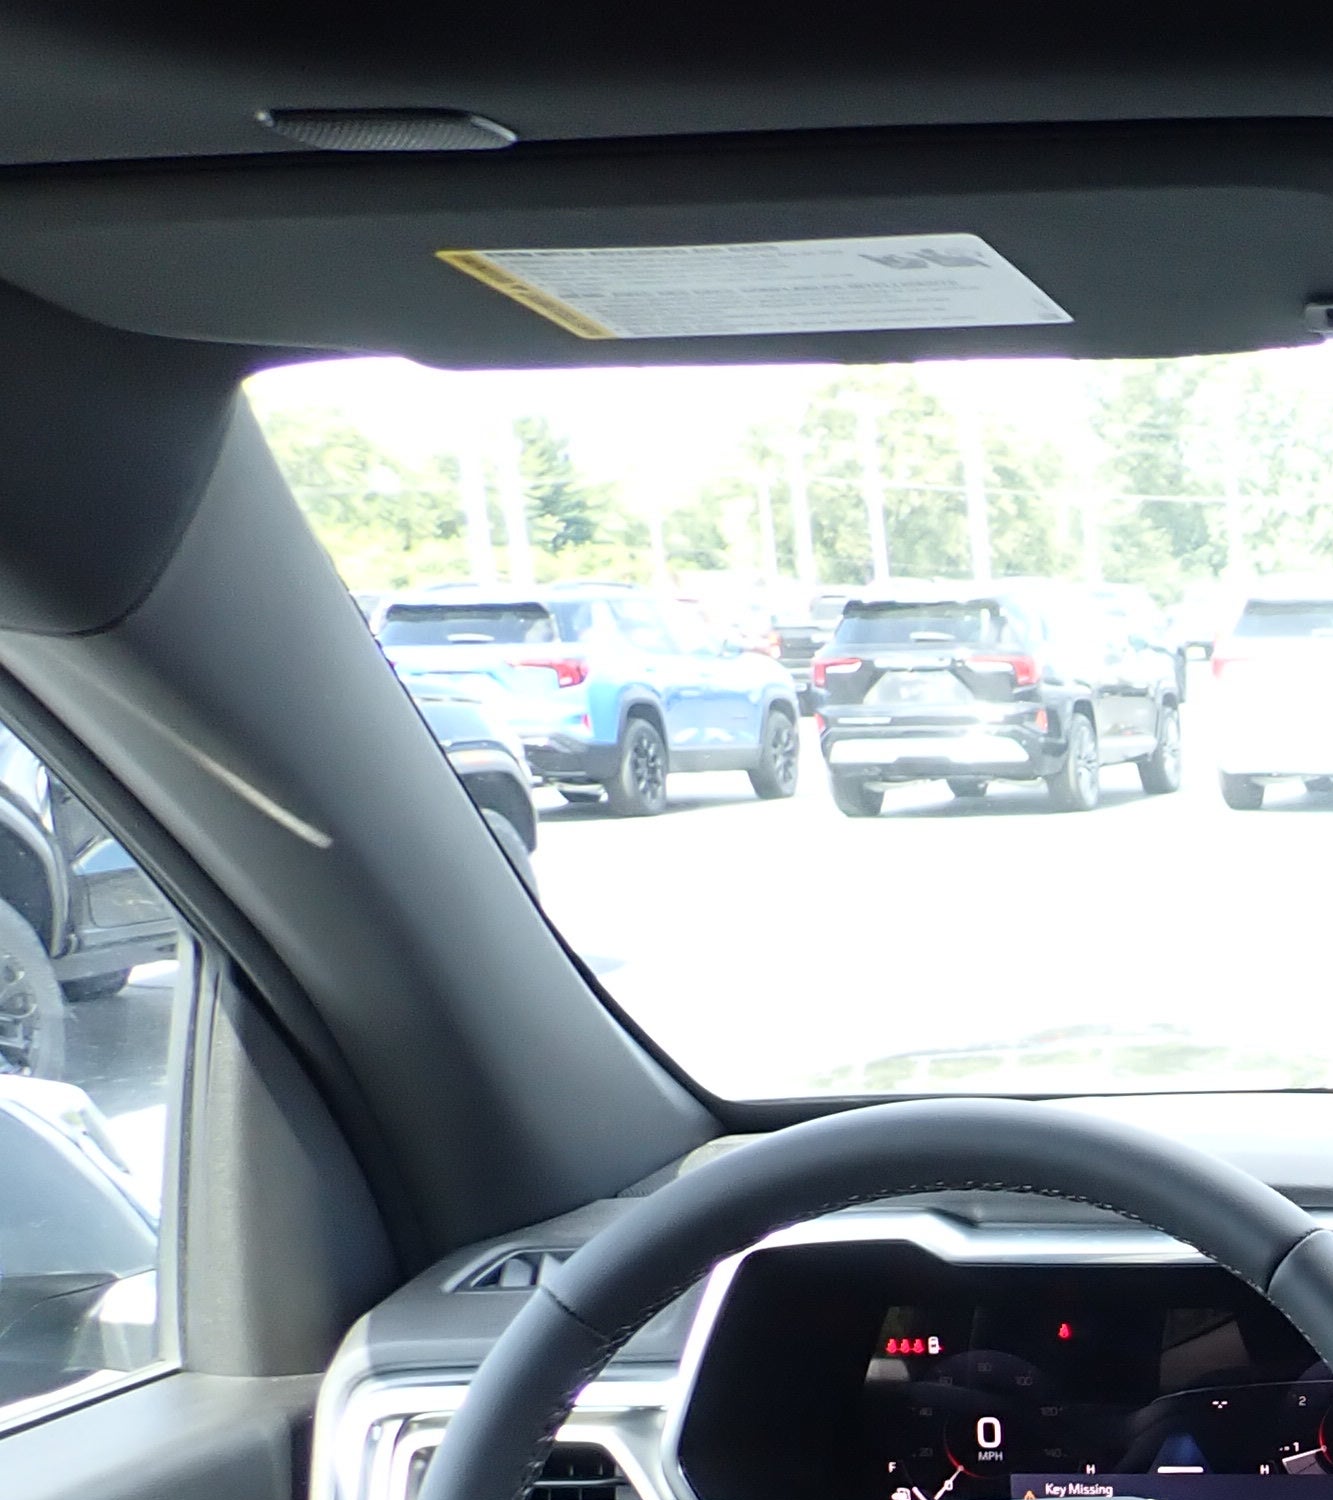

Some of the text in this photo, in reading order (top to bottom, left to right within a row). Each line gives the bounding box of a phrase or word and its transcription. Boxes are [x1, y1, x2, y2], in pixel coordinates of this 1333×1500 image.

[1298, 1395, 1307, 1406] 2
[976, 1416, 1002, 1449] 0
[1293, 1441, 1300, 1452] 1
[978, 1450, 1004, 1462] MPH
[888, 1462, 897, 1472] F
[1085, 1464, 1096, 1474] H
[1260, 1464, 1270, 1474] H
[1045, 1483, 1114, 1498] Key Missing
